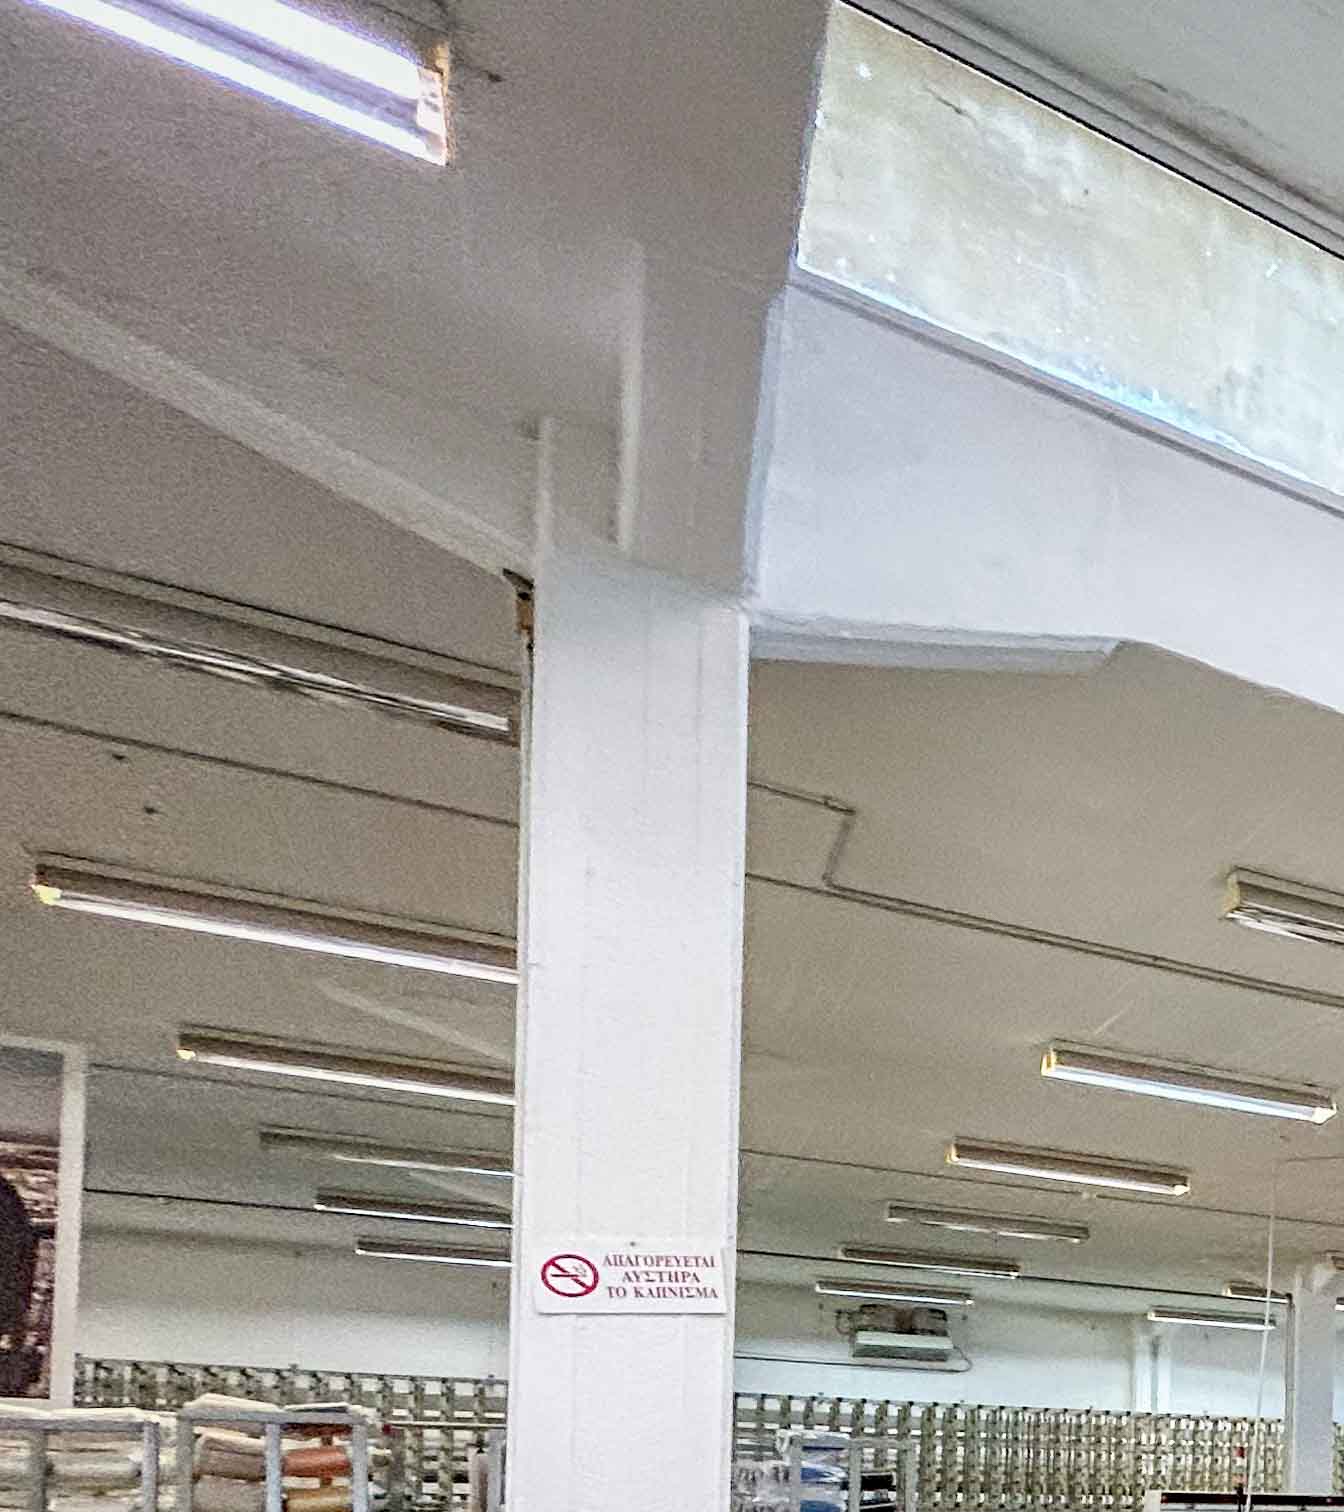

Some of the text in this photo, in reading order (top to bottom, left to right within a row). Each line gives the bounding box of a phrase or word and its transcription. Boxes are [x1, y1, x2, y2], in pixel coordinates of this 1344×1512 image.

[602, 1254, 716, 1268] ΑΠΑΓΟΡΕΥΕΤΑΙ
[622, 1270, 701, 1283] ΑΥΣΤΗΡΑ
[606, 1286, 719, 1299] ΤΟ ΚΑΠΝΙΣΜΑ
